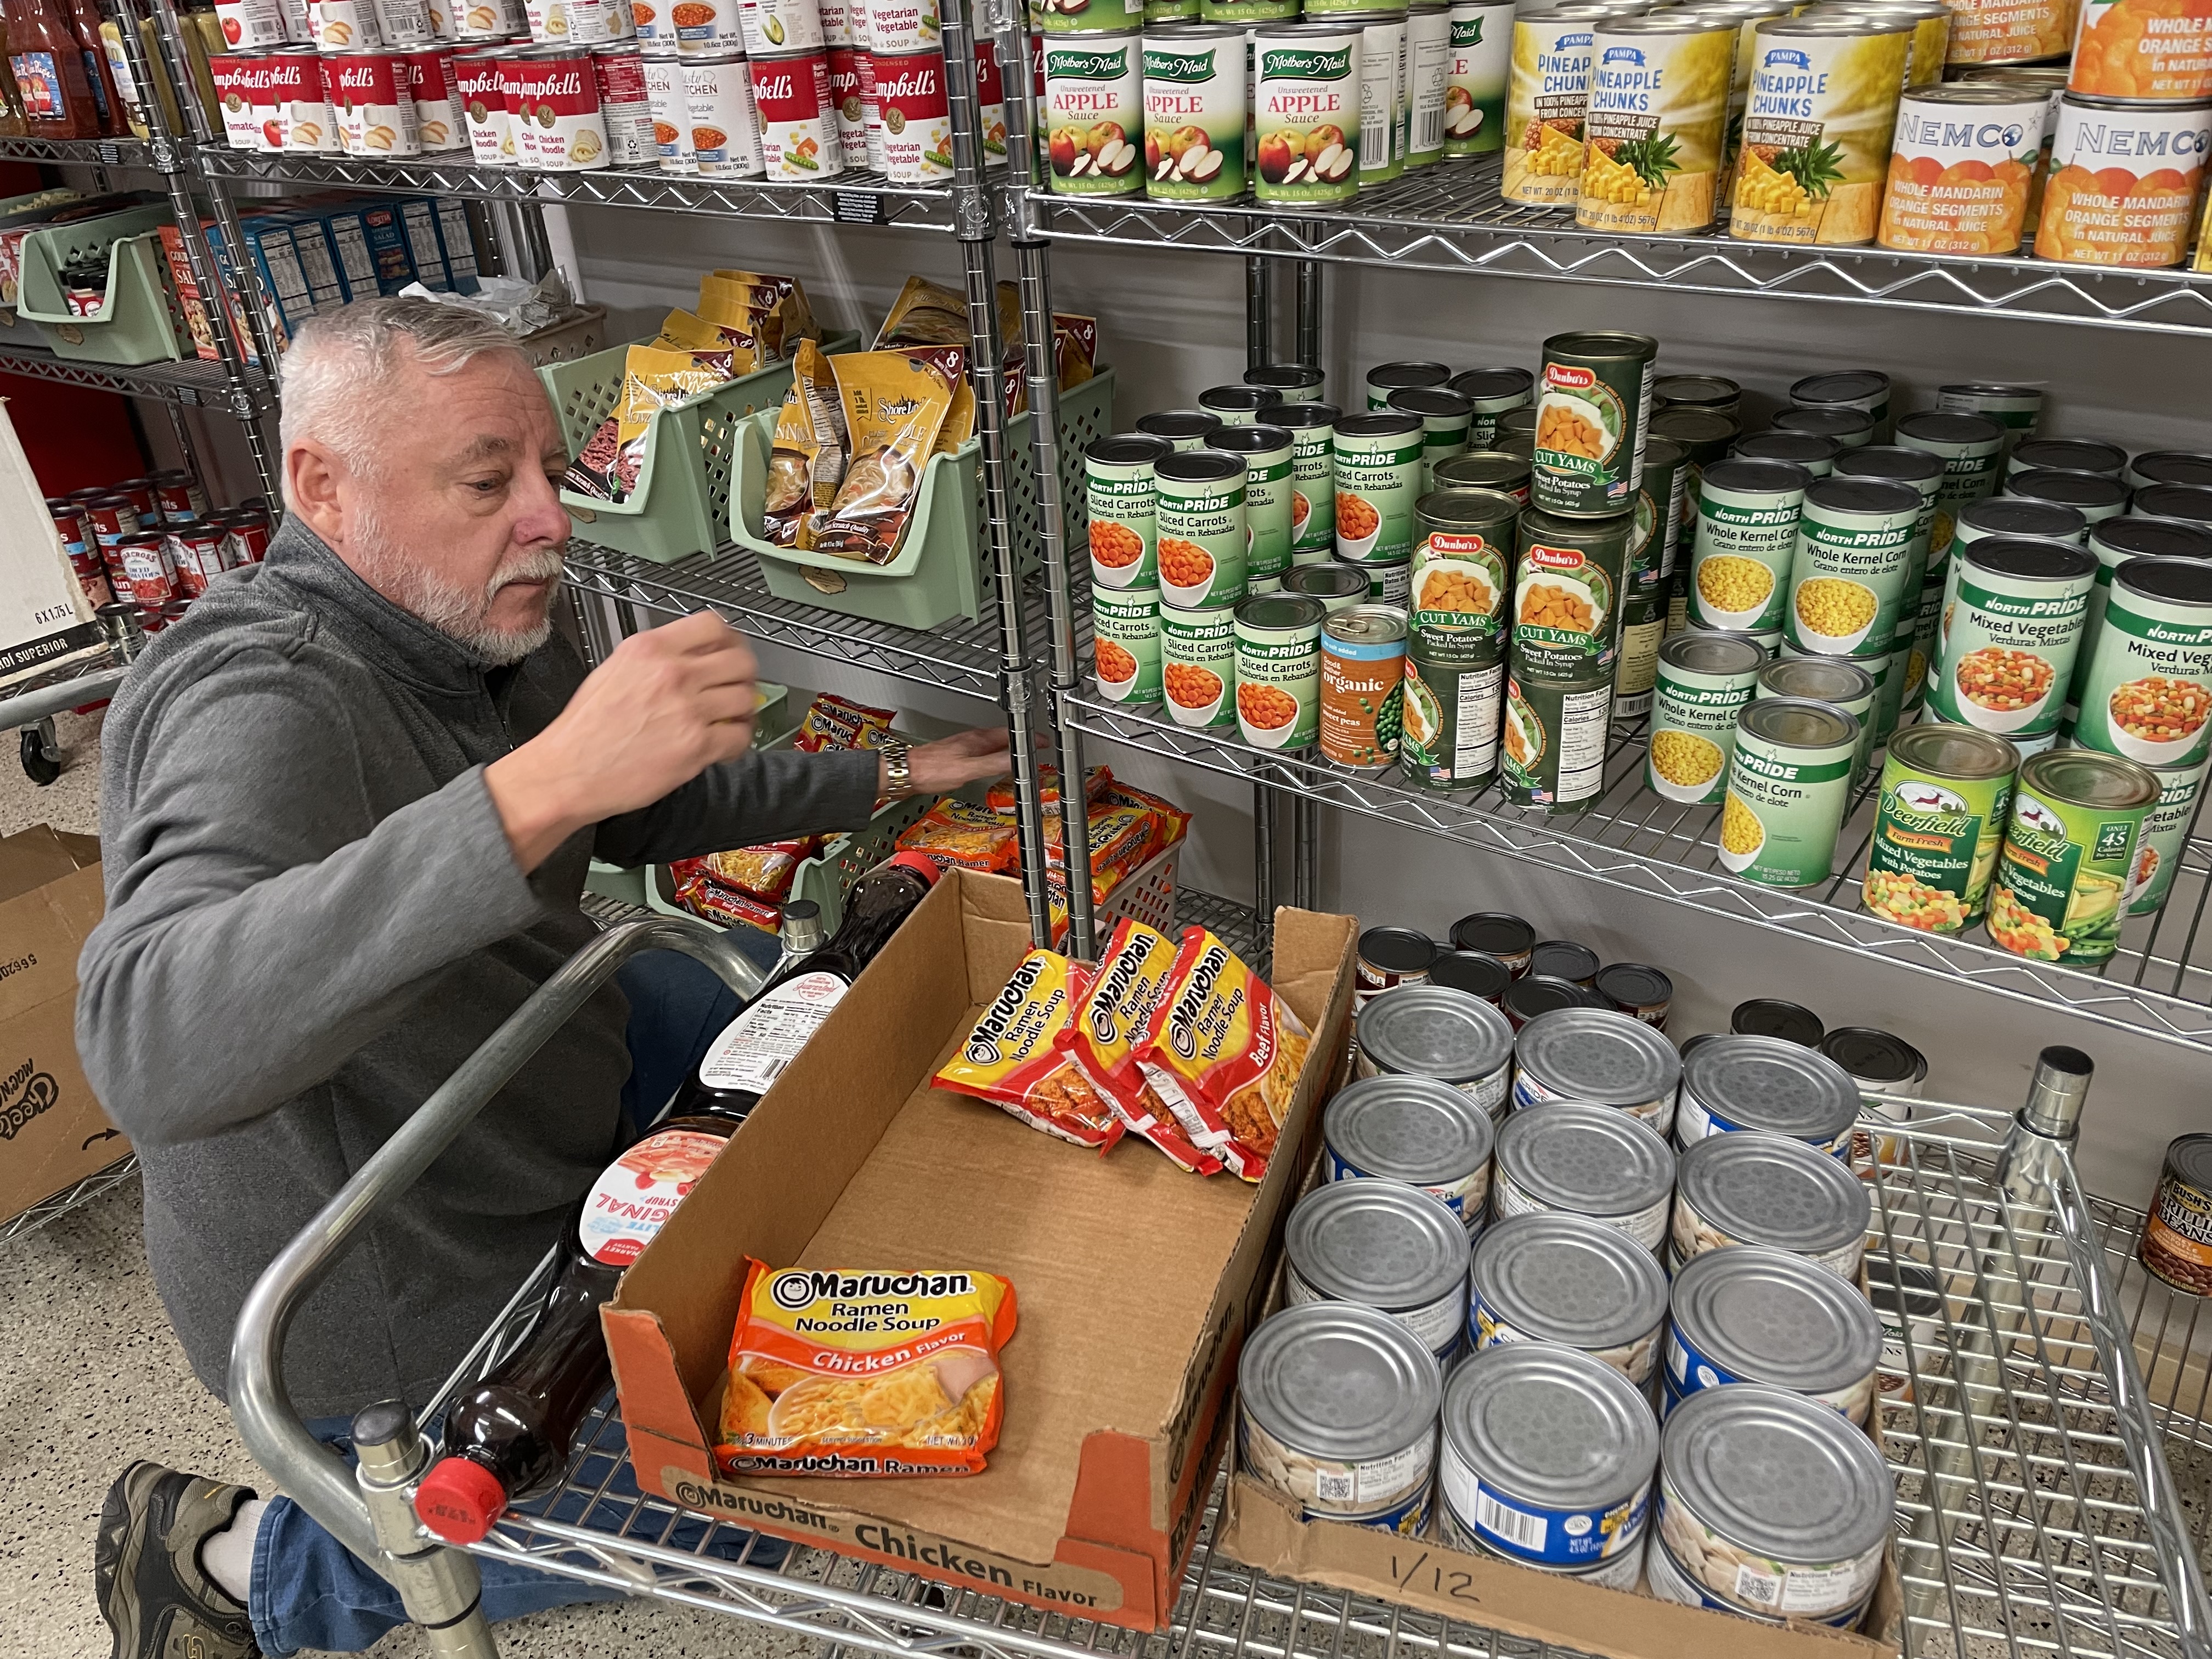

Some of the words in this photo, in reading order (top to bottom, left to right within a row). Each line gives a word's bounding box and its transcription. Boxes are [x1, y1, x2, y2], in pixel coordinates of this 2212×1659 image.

[873, 7, 918, 21] Vegetarian
[1983, 7, 2050, 25] SEGMENTS
[876, 20, 918, 33] Vegetable
[2148, 18, 2203, 34] WHOLE
[886, 39, 909, 48] SOUP
[2138, 38, 2202, 54] ORANGE
[1609, 49, 1637, 59] PAMPA
[1771, 52, 1800, 63] PAMPA
[1049, 55, 1088, 73] Mother's
[1085, 56, 1121, 74] Maid
[1593, 66, 1663, 89] PINEAPPLE
[1753, 69, 1829, 94] PINEAPPLE
[1278, 85, 1328, 93] Unsweetened
[1053, 92, 1119, 110] APPLE
[1146, 95, 1203, 112] APPLE
[1268, 93, 1340, 112] APPLE
[1594, 91, 1649, 111] CHUNKS
[1753, 95, 1812, 117] CHUNKS
[1068, 111, 1099, 120] Sauce
[1154, 113, 1181, 123] Sauce
[1284, 114, 1319, 123] Sauce
[1604, 113, 1635, 126] PINEAPPLE
[1636, 117, 1658, 128] JUICE
[1763, 119, 1797, 132] PINEAPPLE
[1798, 122, 1821, 135] JUICE
[1899, 113, 2023, 148] NEMCO
[476, 139, 497, 148] Noodle
[539, 135, 564, 143] Chicken
[2075, 122, 2211, 157] NEMCO
[1894, 180, 1929, 199] WHOLE
[1932, 184, 2004, 201] MANDARIN
[1889, 196, 1929, 215] ORANGE
[1932, 203, 2004, 217] SEGMENTS
[2072, 192, 2120, 209] WHOLE
[2123, 195, 2190, 210] MANDARIN
[2065, 209, 2116, 227] ORANGE
[2118, 213, 2189, 228] SEGMENTS
[1352, 452, 1397, 465] PRIDE
[1536, 450, 1555, 464] CUT
[1557, 454, 1596, 473] YAMS
[1295, 470, 1330, 481] Rebanadas
[1355, 471, 1393, 482] Carrots
[1090, 494, 1113, 509] Sliced
[1116, 499, 1155, 509] Carrots
[1160, 495, 1183, 510] NORTH
[1184, 496, 1229, 511] PRIDE
[1160, 511, 1184, 526] Sliced
[1187, 516, 1227, 527] Carrots
[1715, 507, 1750, 523] NORTH
[1750, 507, 1800, 524] PRIDE
[1706, 522, 1737, 540] Whole
[1741, 529, 1778, 542] Kernel
[1816, 527, 1853, 545] NORTH
[1854, 528, 1908, 546] PRIDE
[1807, 543, 1839, 562] Whole
[1842, 552, 1883, 565] Kernel
[1885, 550, 1906, 563] Corn
[35, 613, 42, 624] 6
[41, 611, 49, 622] X
[48, 605, 66, 619] 1.75
[65, 603, 73, 614] L
[1110, 605, 1152, 617] PRIDE
[1985, 596, 2030, 615] NORTH
[2030, 596, 2086, 616] PRIDE
[1113, 619, 1149, 631] Carrots
[1420, 612, 1447, 623] CUT
[1450, 613, 1487, 627] YAMS
[1970, 611, 2013, 633] Mixed
[2017, 616, 2085, 639] Vegetables
[1421, 629, 1443, 641] Sweet
[1446, 633, 1483, 642] Potatoes
[1520, 625, 1547, 639] CUT
[1549, 628, 1588, 646] YAMS
[1989, 633, 2036, 647] Verduras
[2038, 636, 2071, 647] Mixtas
[2147, 624, 2196, 643] NORTH
[15, 639, 67, 663] SUPERIOR
[1242, 642, 1268, 657] NORTH
[1268, 642, 1313, 657] PRIDE
[1338, 647, 1357, 656] added
[1520, 644, 1543, 658] Sweet
[1545, 650, 1583, 661] Potatoes
[2128, 640, 2179, 663] Mixed
[1242, 657, 1268, 672] Sliced
[1272, 660, 1311, 673] Carrots
[2151, 662, 2200, 675] Verduras
[1323, 671, 1384, 694] organic
[1666, 684, 1697, 702] NORTH
[1698, 689, 1750, 704] PRIDE
[1659, 696, 1686, 716] Whole
[1689, 708, 1726, 721] Kernel
[1340, 717, 1361, 726] peas
[1743, 754, 1799, 780] PRIDE
[1737, 769, 1768, 793] Kernel
[1771, 785, 1802, 799] Corn
[1882, 791, 1972, 837] Deerfield
[1892, 832, 1914, 843] Farm
[2102, 832, 2126, 846] 45
[1875, 833, 1901, 858] Mixed
[1904, 850, 1968, 869] Vegetables
[959, 859, 989, 867] Ramen
[1882, 855, 1898, 869] with
[1900, 863, 1942, 879] Potatoes
[2018, 855, 2041, 868] Fresh
[2004, 879, 2037, 902] Potatoes
[2007, 866, 2066, 898] Vegetables
[1094, 933, 1157, 1021] Maruchan
[1173, 946, 1230, 1029] Maruchan
[975, 957, 1045, 1043] Maruchan
[1120, 976, 1152, 1021] Ramen
[1005, 1000, 1040, 1043] Ramen
[1198, 993, 1226, 1038] Ramen
[1201, 1019, 1231, 1062] Noodle
[1222, 988, 1245, 1026] Soup
[1259, 1002, 1274, 1038] Flavor
[1008, 1019, 1046, 1064] Noodle
[1037, 988, 1066, 1025] Soup
[1249, 1034, 1274, 1069] Beef
[645, 1196, 678, 1206] SYRUP
[2172, 1182, 2212, 1212] BUSH'S
[811, 1272, 969, 1299] Maruchan
[831, 1303, 909, 1316] Ramen
[795, 1317, 878, 1331] Noodle
[882, 1317, 940, 1331] Soup
[813, 1349, 912, 1373] Chicken
[916, 1331, 966, 1354] Flavor
[746, 1432, 755, 1445] 3
[756, 1455, 875, 1472] Maruchan
[884, 1460, 969, 1474] Ramen
[698, 1483, 827, 1532] Maruchan
[854, 1523, 1014, 1589] Chicken
[1022, 1578, 1098, 1609] Flavor
[1391, 1552, 1481, 1604] 1/12
